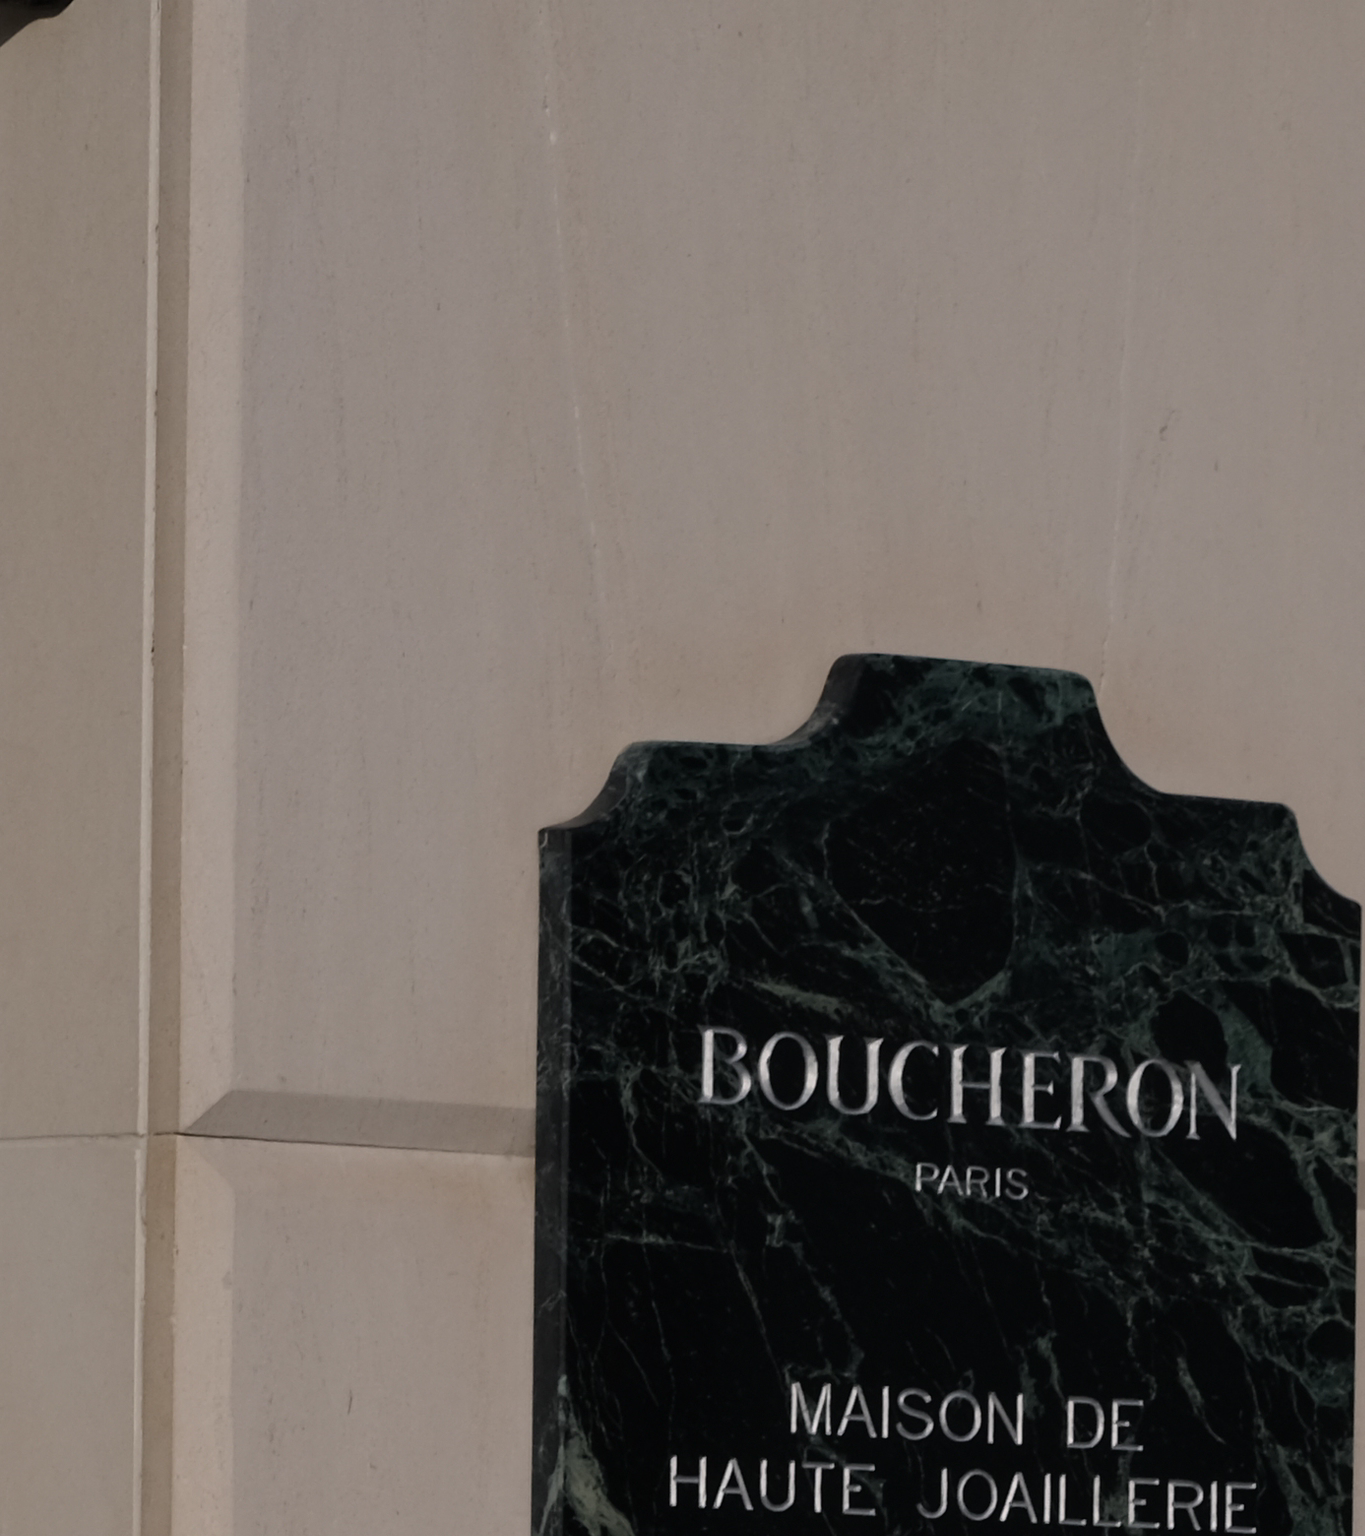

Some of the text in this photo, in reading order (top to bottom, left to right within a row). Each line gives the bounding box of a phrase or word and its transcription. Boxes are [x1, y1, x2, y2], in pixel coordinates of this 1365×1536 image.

[698, 1024, 1242, 1143] BOUCHERON
[914, 1161, 1030, 1201] PARIS
[787, 1381, 1146, 1452] MAISON DE
[667, 1455, 1258, 1535] HAUTE JOAILLERIE
